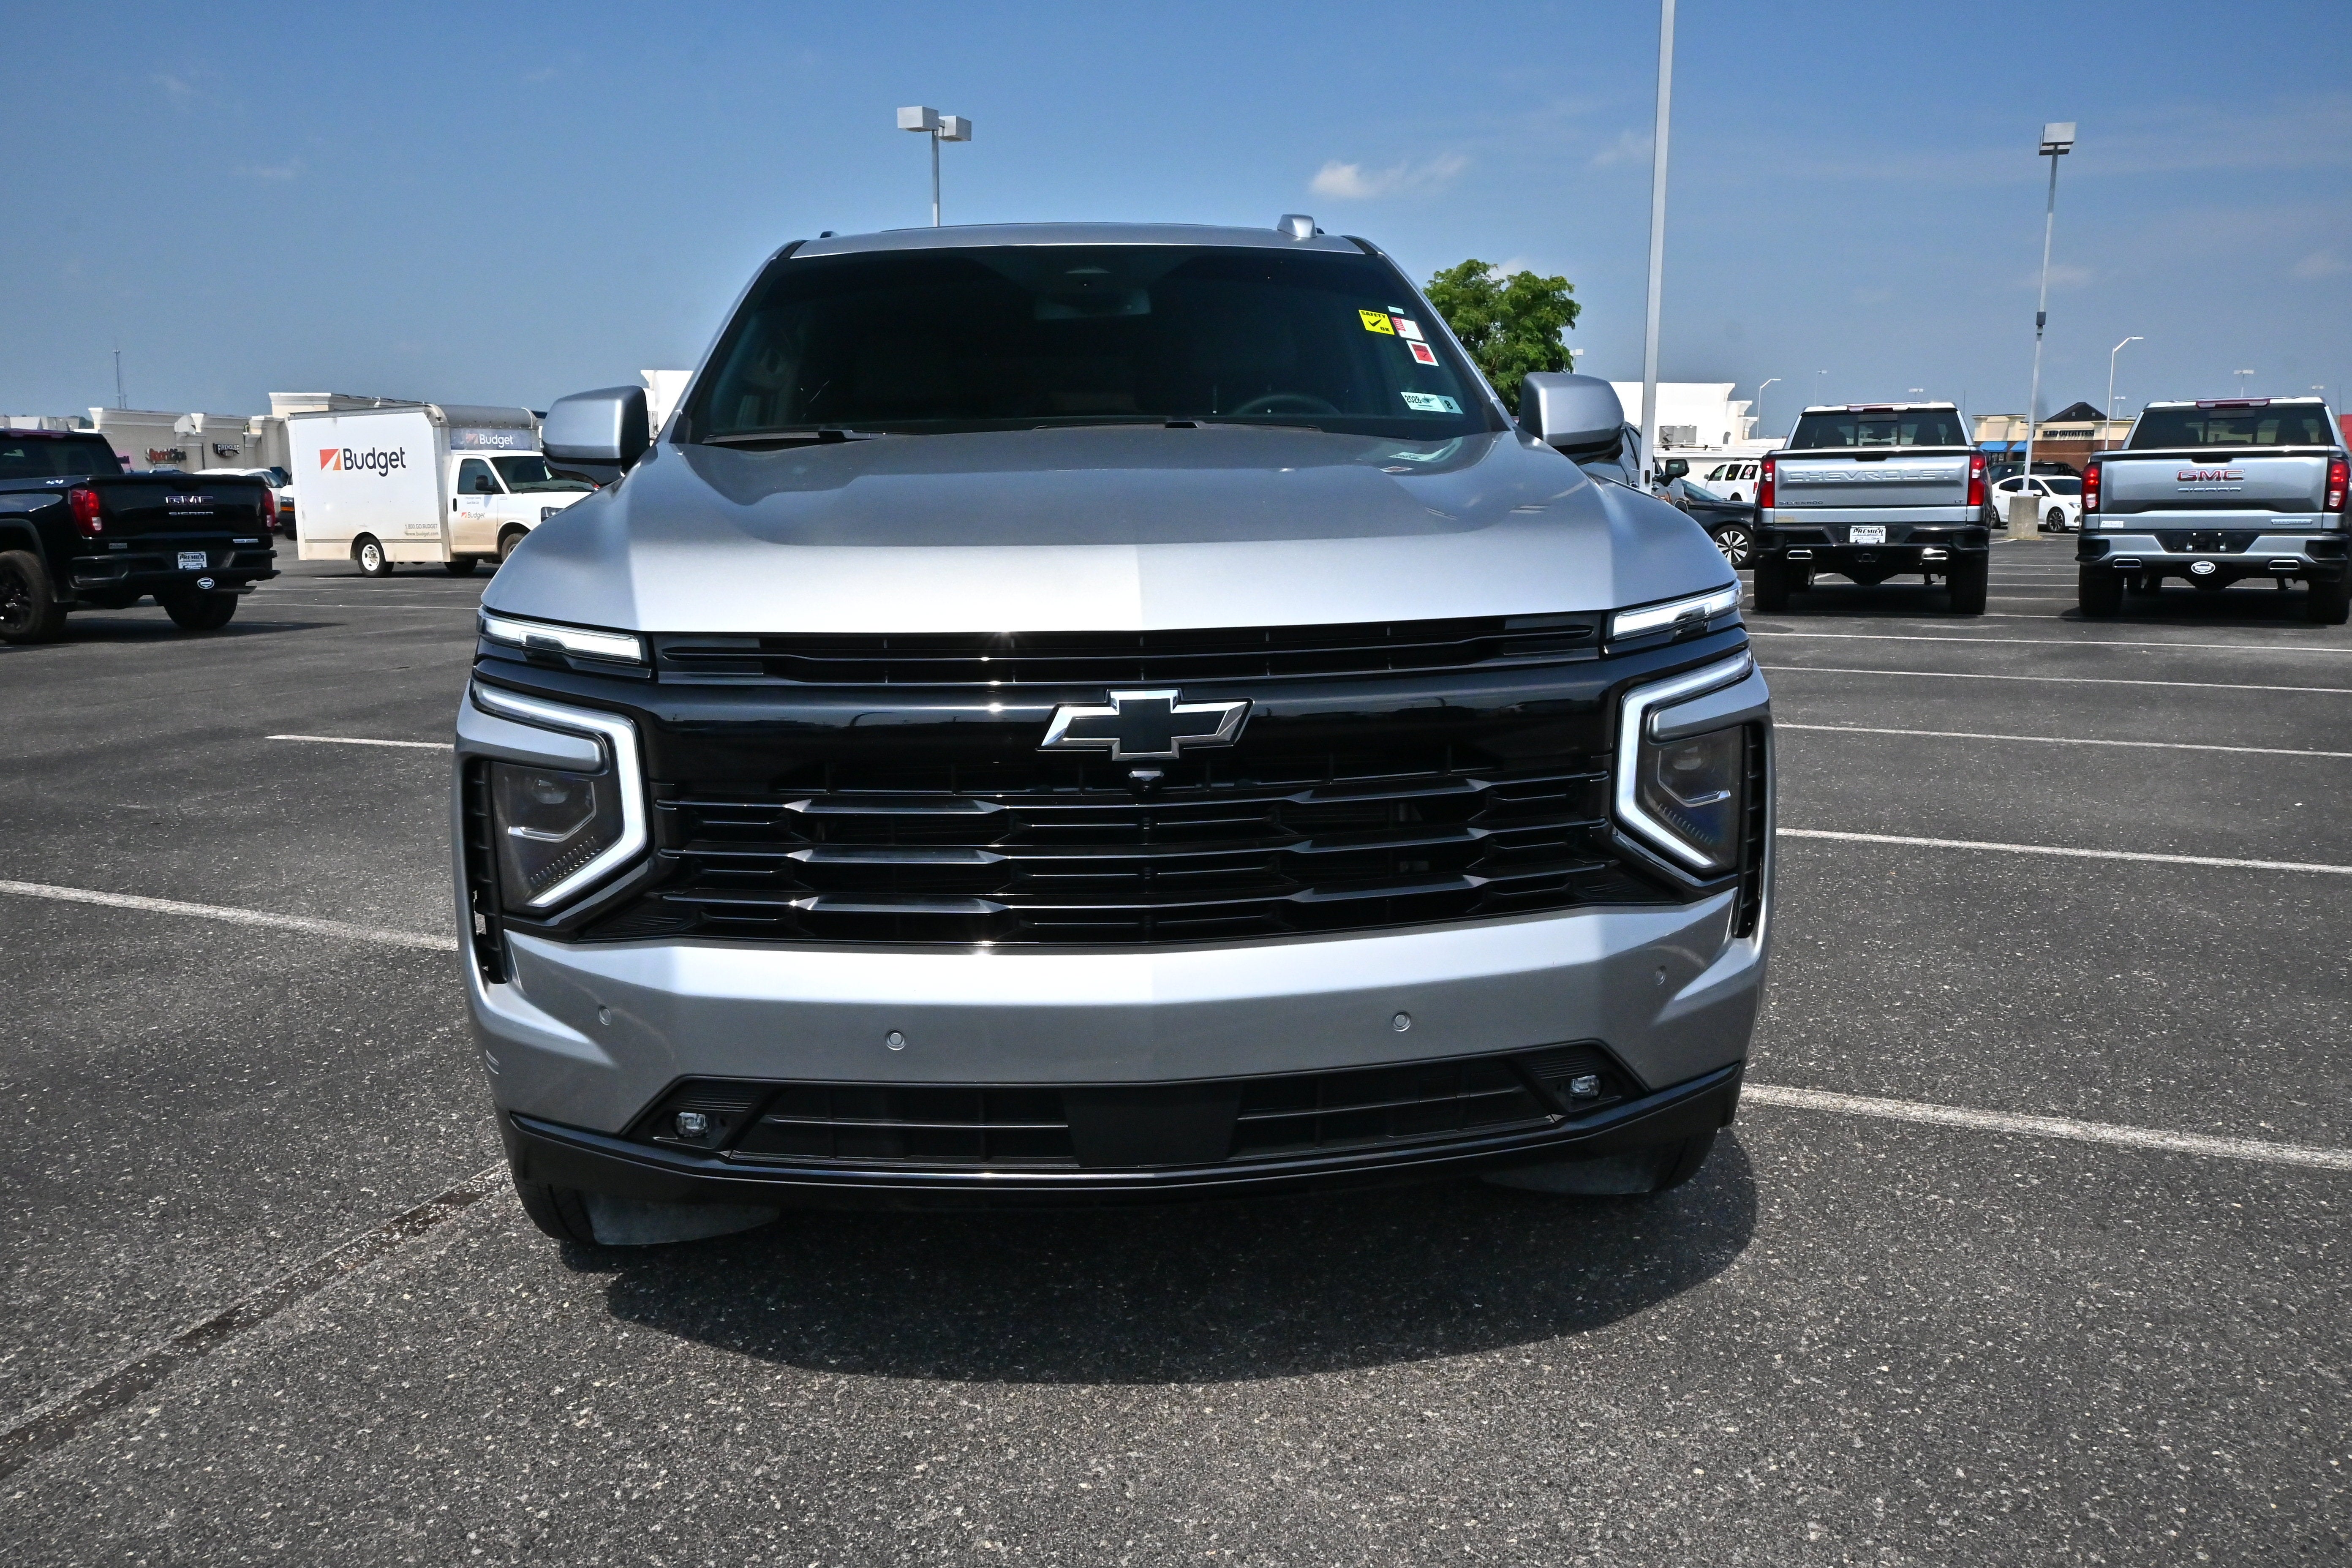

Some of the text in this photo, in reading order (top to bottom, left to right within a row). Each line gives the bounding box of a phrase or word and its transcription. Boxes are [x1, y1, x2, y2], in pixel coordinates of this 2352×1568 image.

[1405, 395, 1422, 404] 2028
[1444, 400, 1453, 410] 8
[479, 434, 514, 448] Budget
[343, 446, 406, 477] Budget
[1787, 469, 1955, 482] CHEVROLET
[2177, 469, 2245, 482] GMC
[166, 495, 213, 505] GMC
[468, 512, 485, 520] Budget
[1853, 528, 1883, 536] PREMIER
